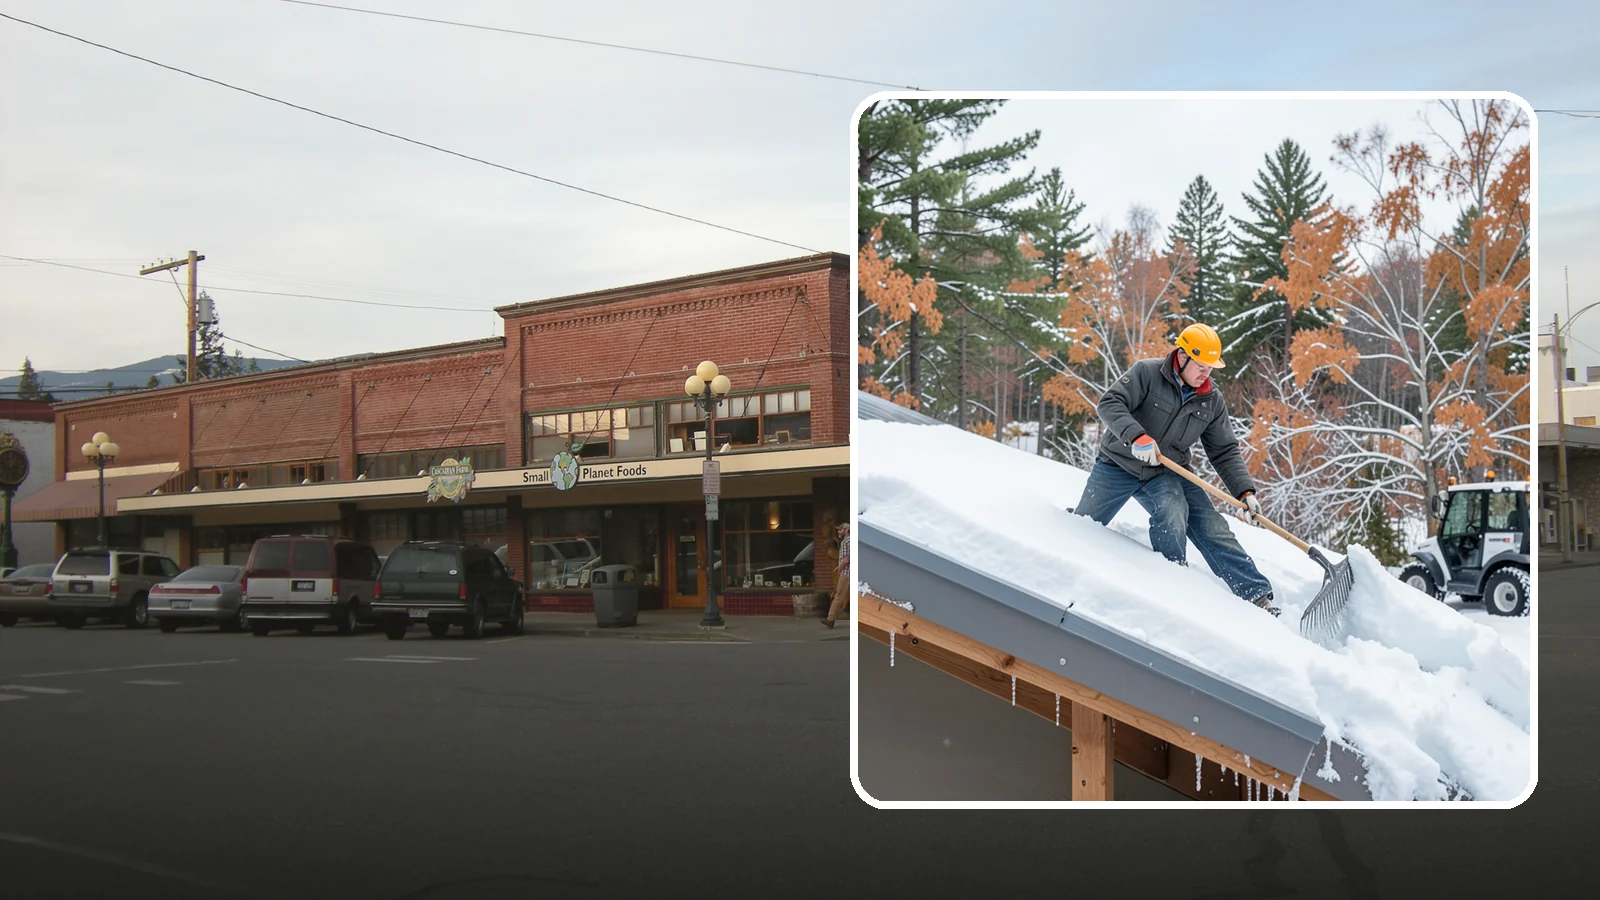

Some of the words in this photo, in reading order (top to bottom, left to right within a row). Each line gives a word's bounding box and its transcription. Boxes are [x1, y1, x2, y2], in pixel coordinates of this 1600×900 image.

[523, 471, 549, 482] Small
[583, 467, 614, 479] Planet
[617, 464, 647, 477] Foods
